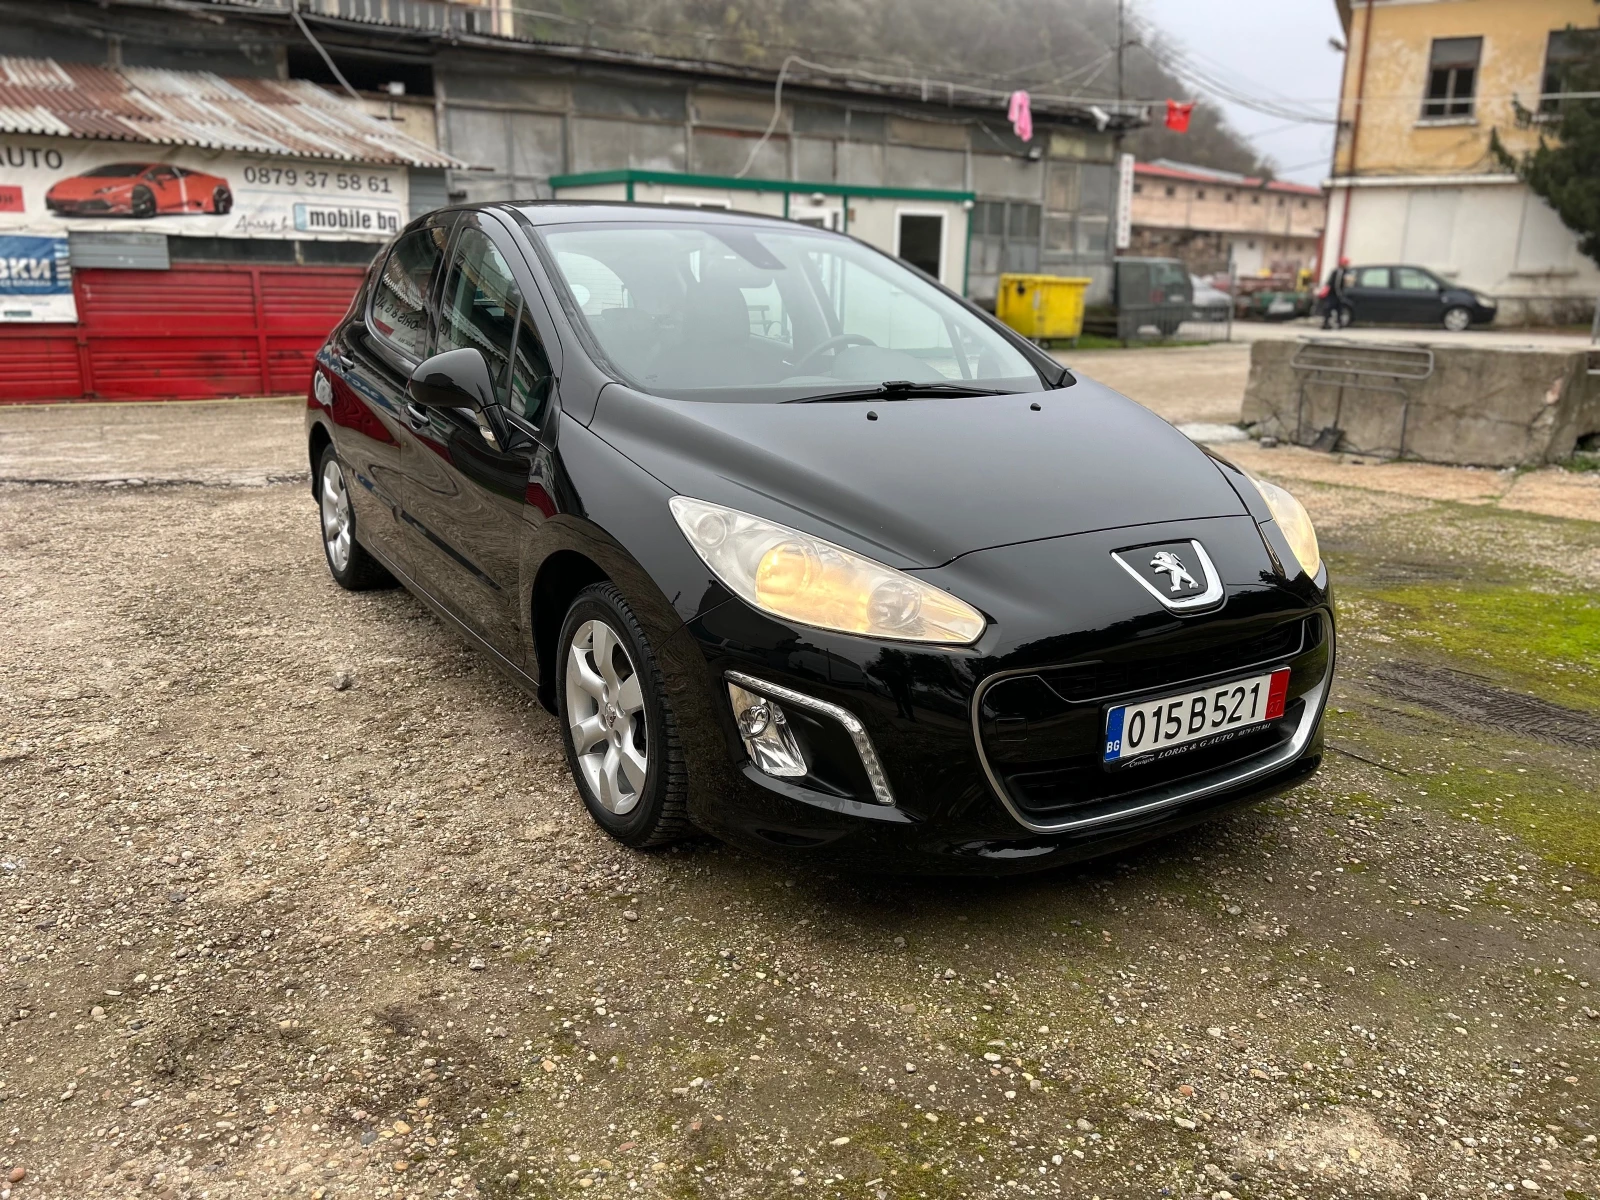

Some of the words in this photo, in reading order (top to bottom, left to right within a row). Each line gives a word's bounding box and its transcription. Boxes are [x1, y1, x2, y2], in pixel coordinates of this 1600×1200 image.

[0, 146, 64, 170] UTO
[244, 166, 298, 187] 0879
[305, 170, 329, 188] 37
[336, 173, 362, 190] 58
[367, 176, 393, 194] 61
[1128, 682, 1260, 748] 015B521
[1106, 739, 1121, 754] BG
[1157, 745, 1189, 759] LORIS
[1189, 743, 1198, 751] &
[1199, 739, 1208, 748] G
[1207, 732, 1234, 746] AUTO
